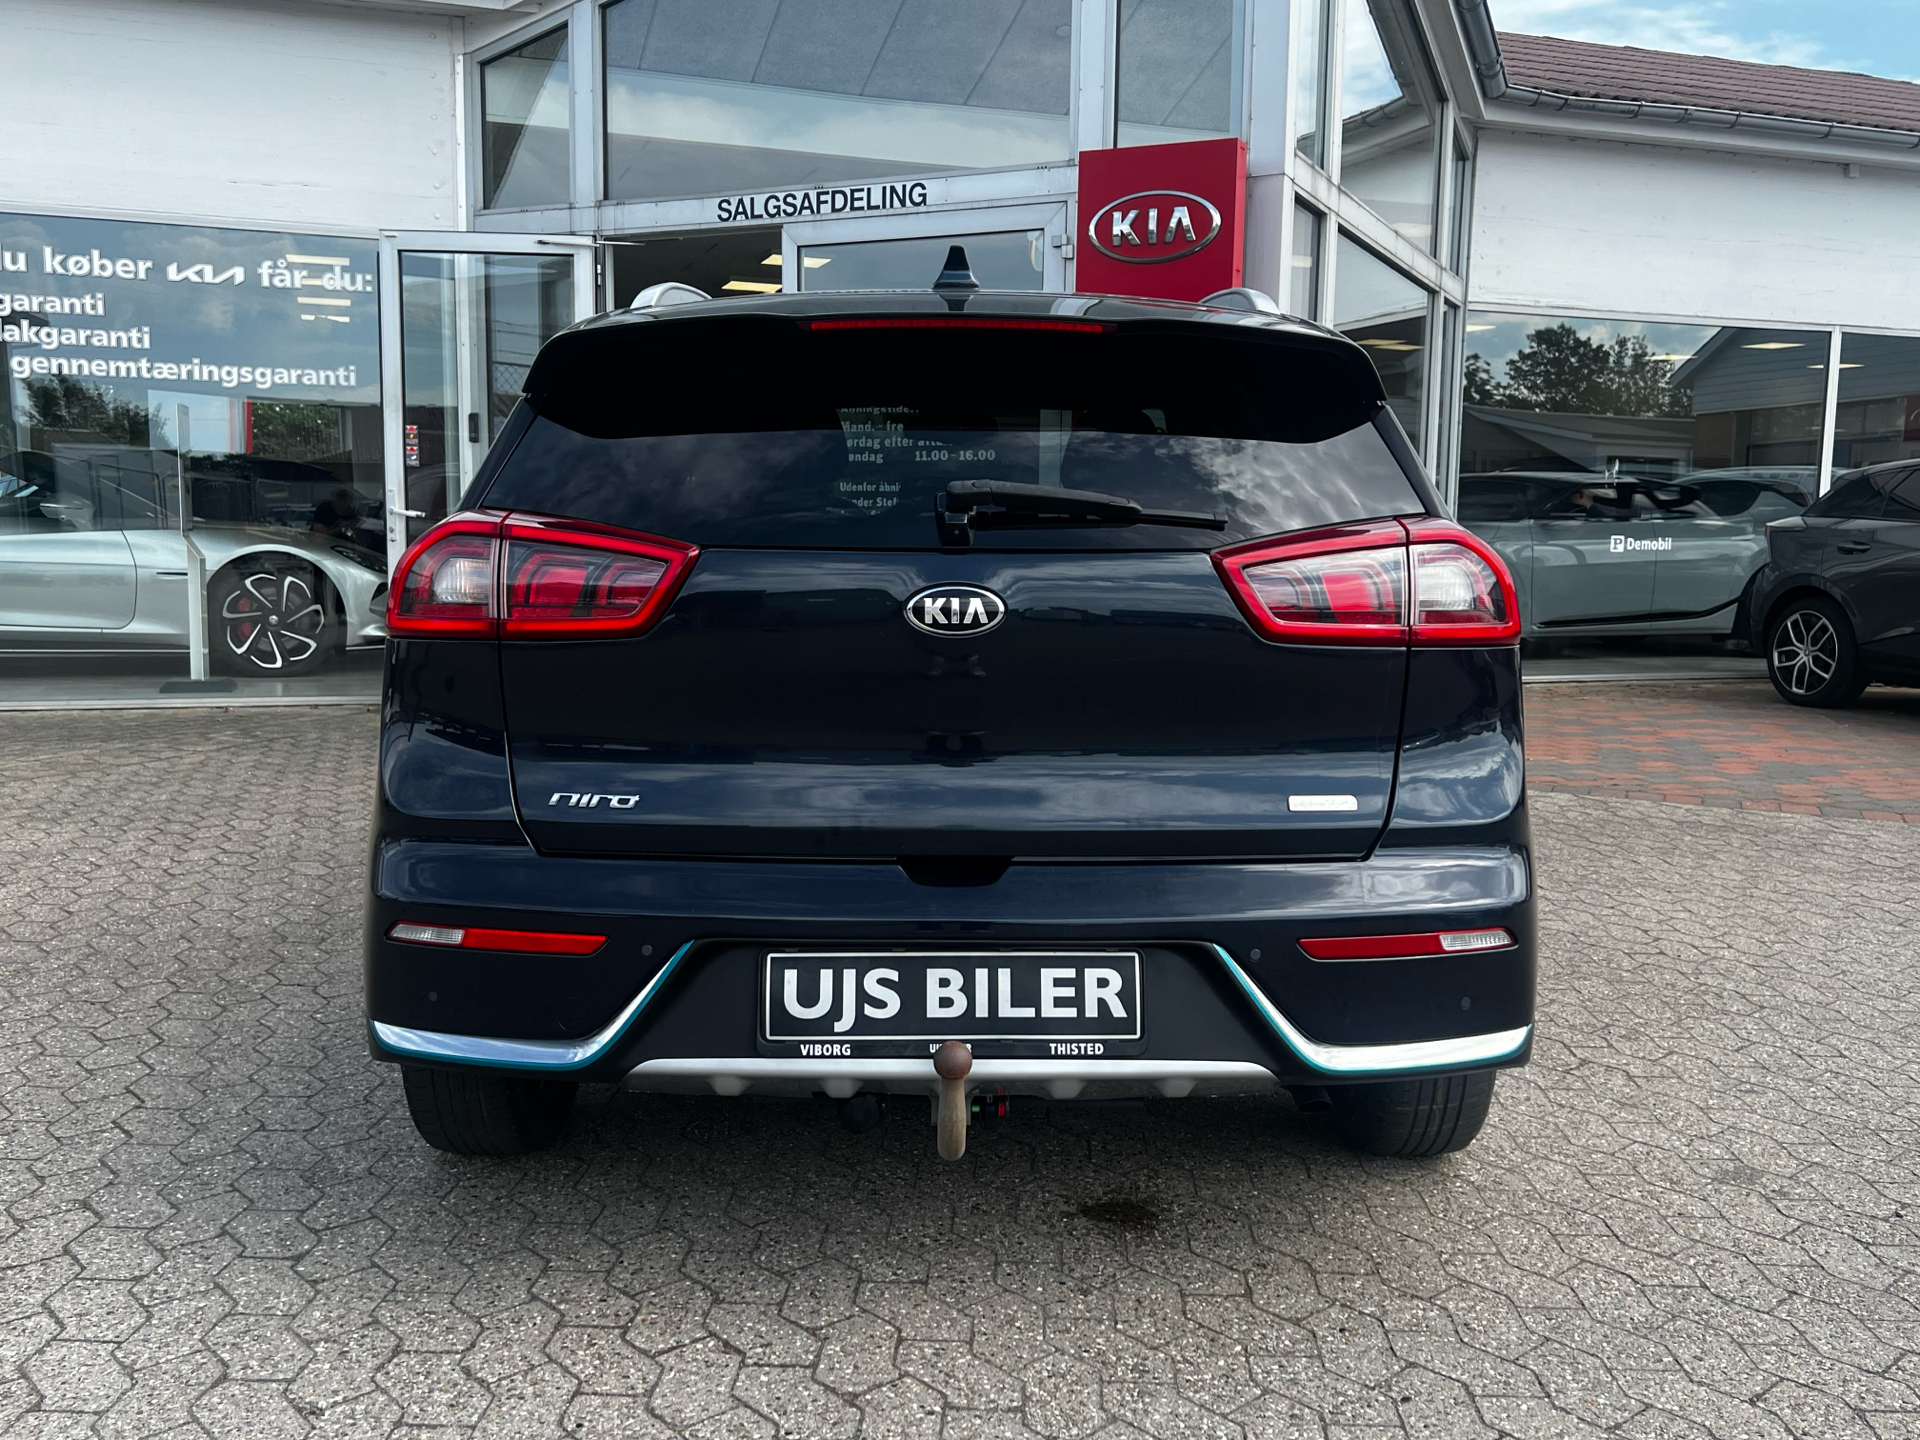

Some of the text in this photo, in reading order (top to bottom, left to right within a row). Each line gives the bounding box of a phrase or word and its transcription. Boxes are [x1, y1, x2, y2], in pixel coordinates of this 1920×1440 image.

[717, 182, 927, 222] SALGSAFDELING
[1112, 206, 1196, 247] KIA
[0, 243, 28, 272] u
[43, 245, 153, 281] køber
[257, 258, 308, 289] får
[322, 265, 373, 292] du:
[0, 317, 151, 350] akgaranti
[10, 353, 357, 389] gennemtæringsgaranti
[876, 497, 899, 507] Stef
[1626, 537, 1672, 550] Demobil
[923, 597, 989, 624] KIA
[548, 792, 640, 809] niro
[783, 967, 1128, 1033] UJS BILER
[800, 1043, 1104, 1056] VIBORG THISTED
